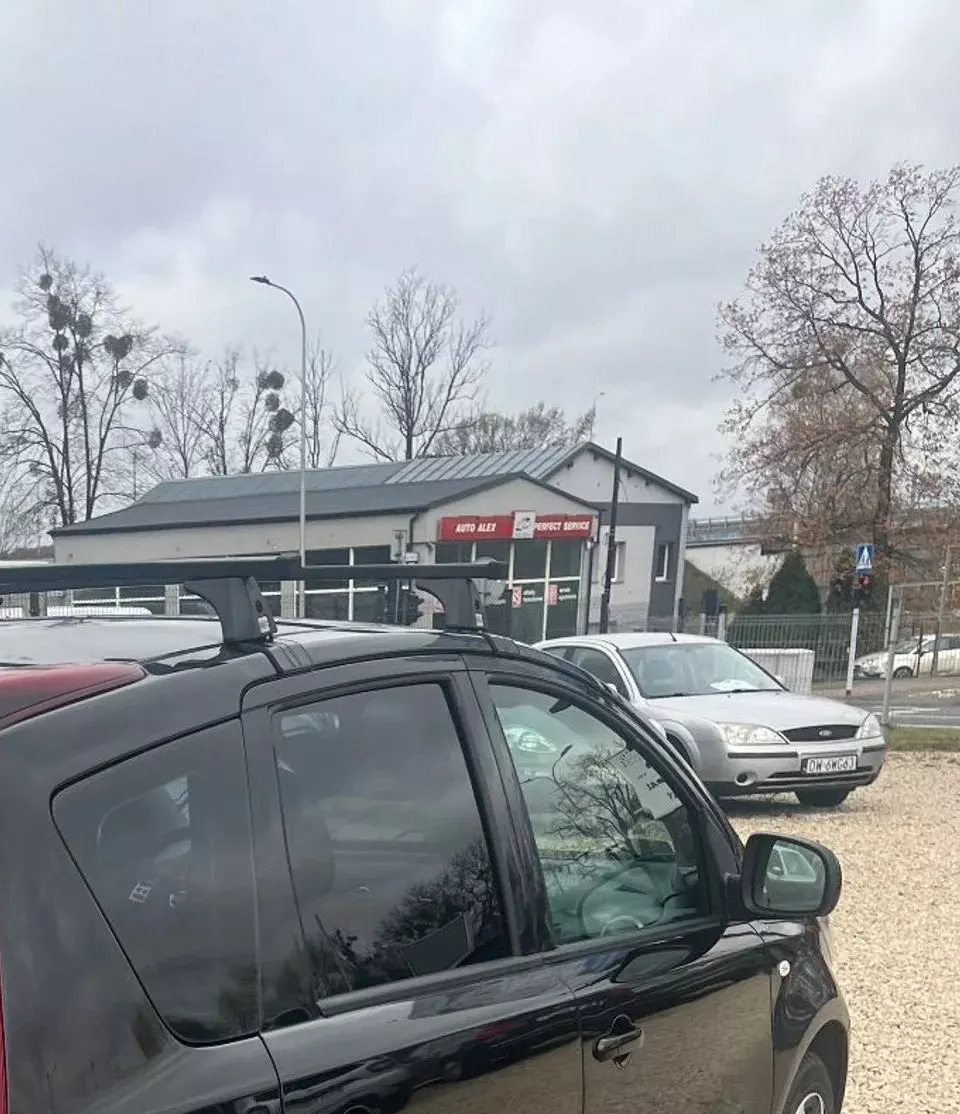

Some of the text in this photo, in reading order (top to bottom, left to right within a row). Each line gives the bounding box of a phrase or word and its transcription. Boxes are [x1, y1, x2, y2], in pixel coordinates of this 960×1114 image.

[455, 522, 497, 533] AUTO ALEX
[563, 520, 591, 531] SERVICE
